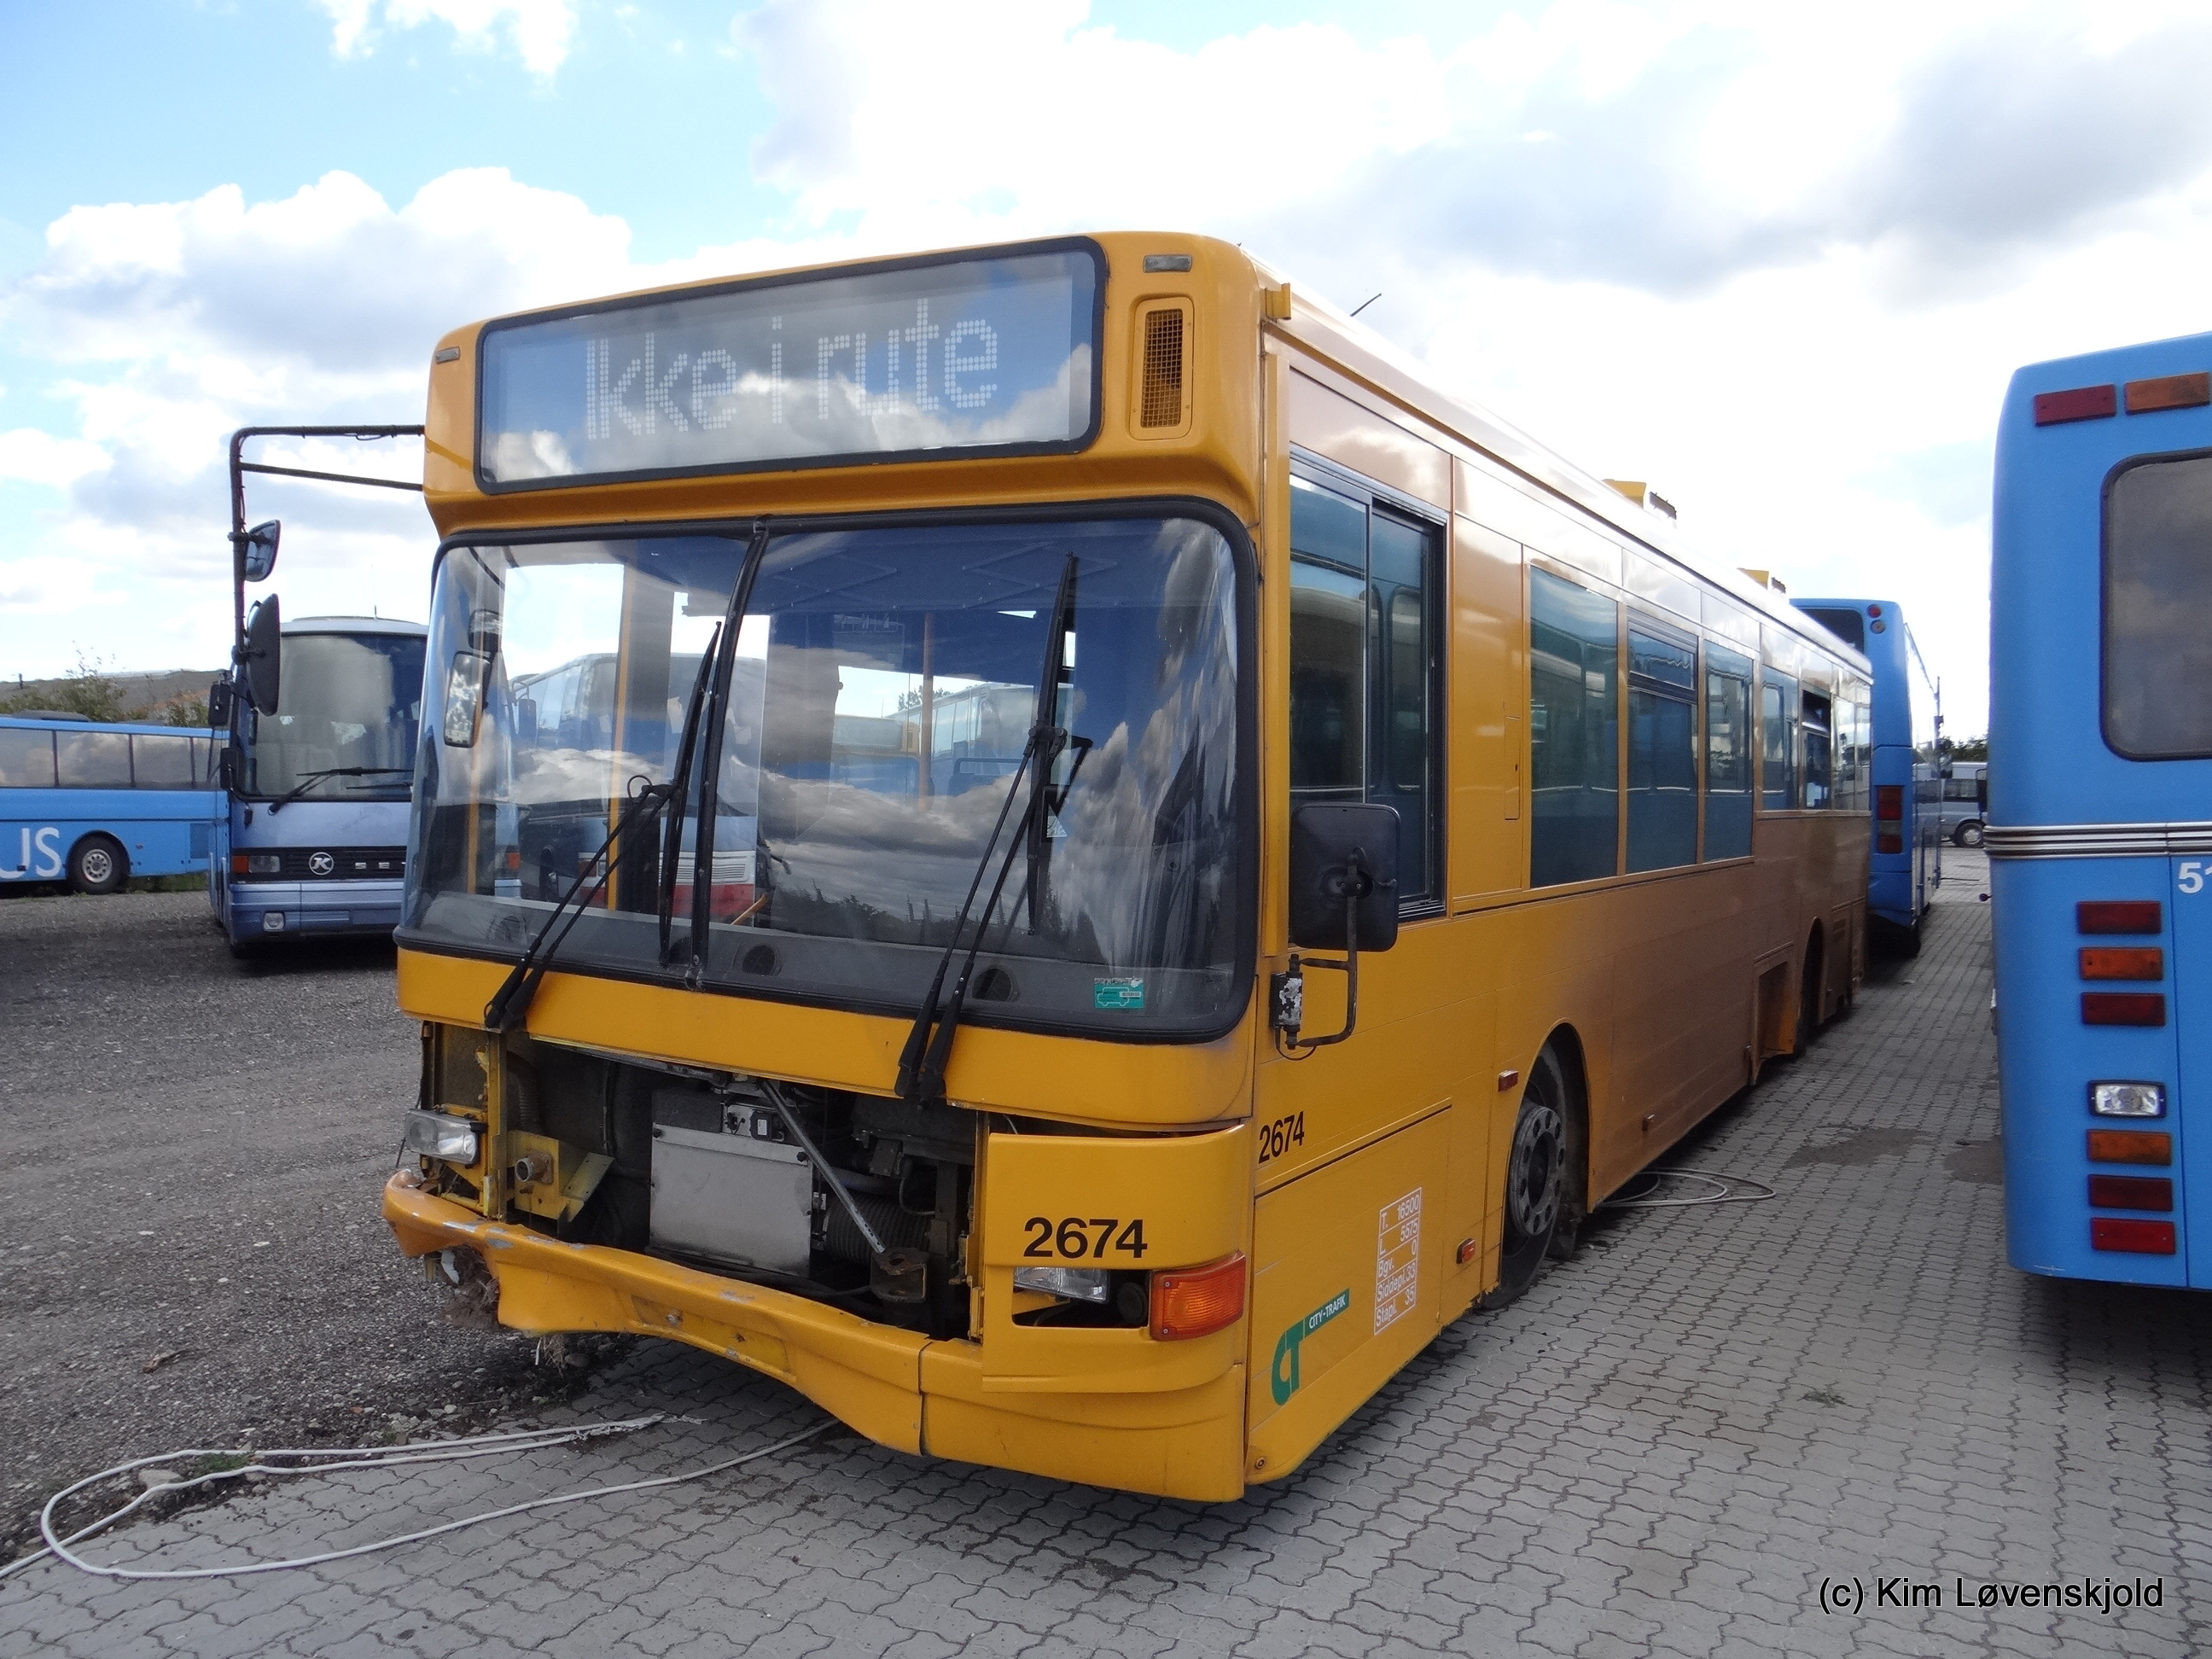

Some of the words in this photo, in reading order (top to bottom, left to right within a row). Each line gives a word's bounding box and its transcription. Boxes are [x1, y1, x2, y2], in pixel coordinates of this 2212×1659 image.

[586, 331, 736, 440] Ikke
[771, 315, 783, 424] i
[818, 297, 998, 420] rute
[2178, 862, 2212, 894] 5
[1258, 1110, 1305, 1164] 2674
[1397, 1194, 1419, 1220] 16500
[1023, 1216, 1148, 1259] 2674
[1400, 1217, 1418, 1242] 5575
[1411, 1238, 1417, 1255] 0
[1406, 1262, 1416, 1282] 33
[1404, 1285, 1414, 1305] 35
[1308, 1294, 1347, 1330] CITY-TRAFIK
